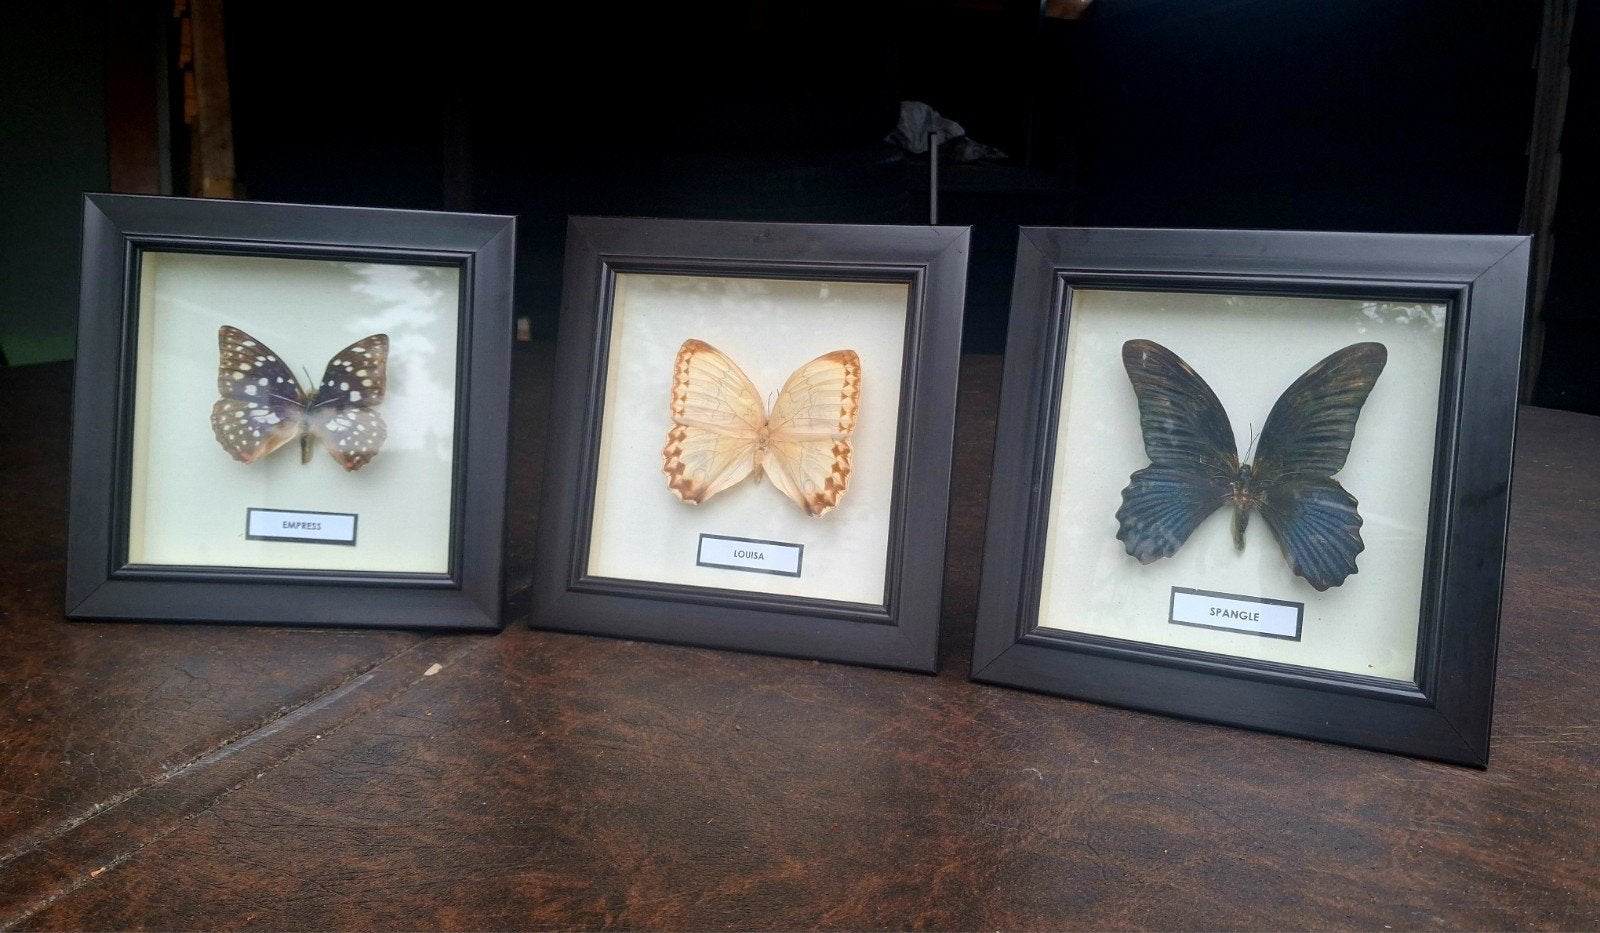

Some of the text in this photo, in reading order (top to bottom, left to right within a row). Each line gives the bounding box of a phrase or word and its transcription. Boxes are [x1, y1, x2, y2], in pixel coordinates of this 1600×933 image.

[282, 520, 322, 531] EMPRESS
[733, 549, 765, 560] LOUISA
[1209, 606, 1260, 622] SPANGLE
